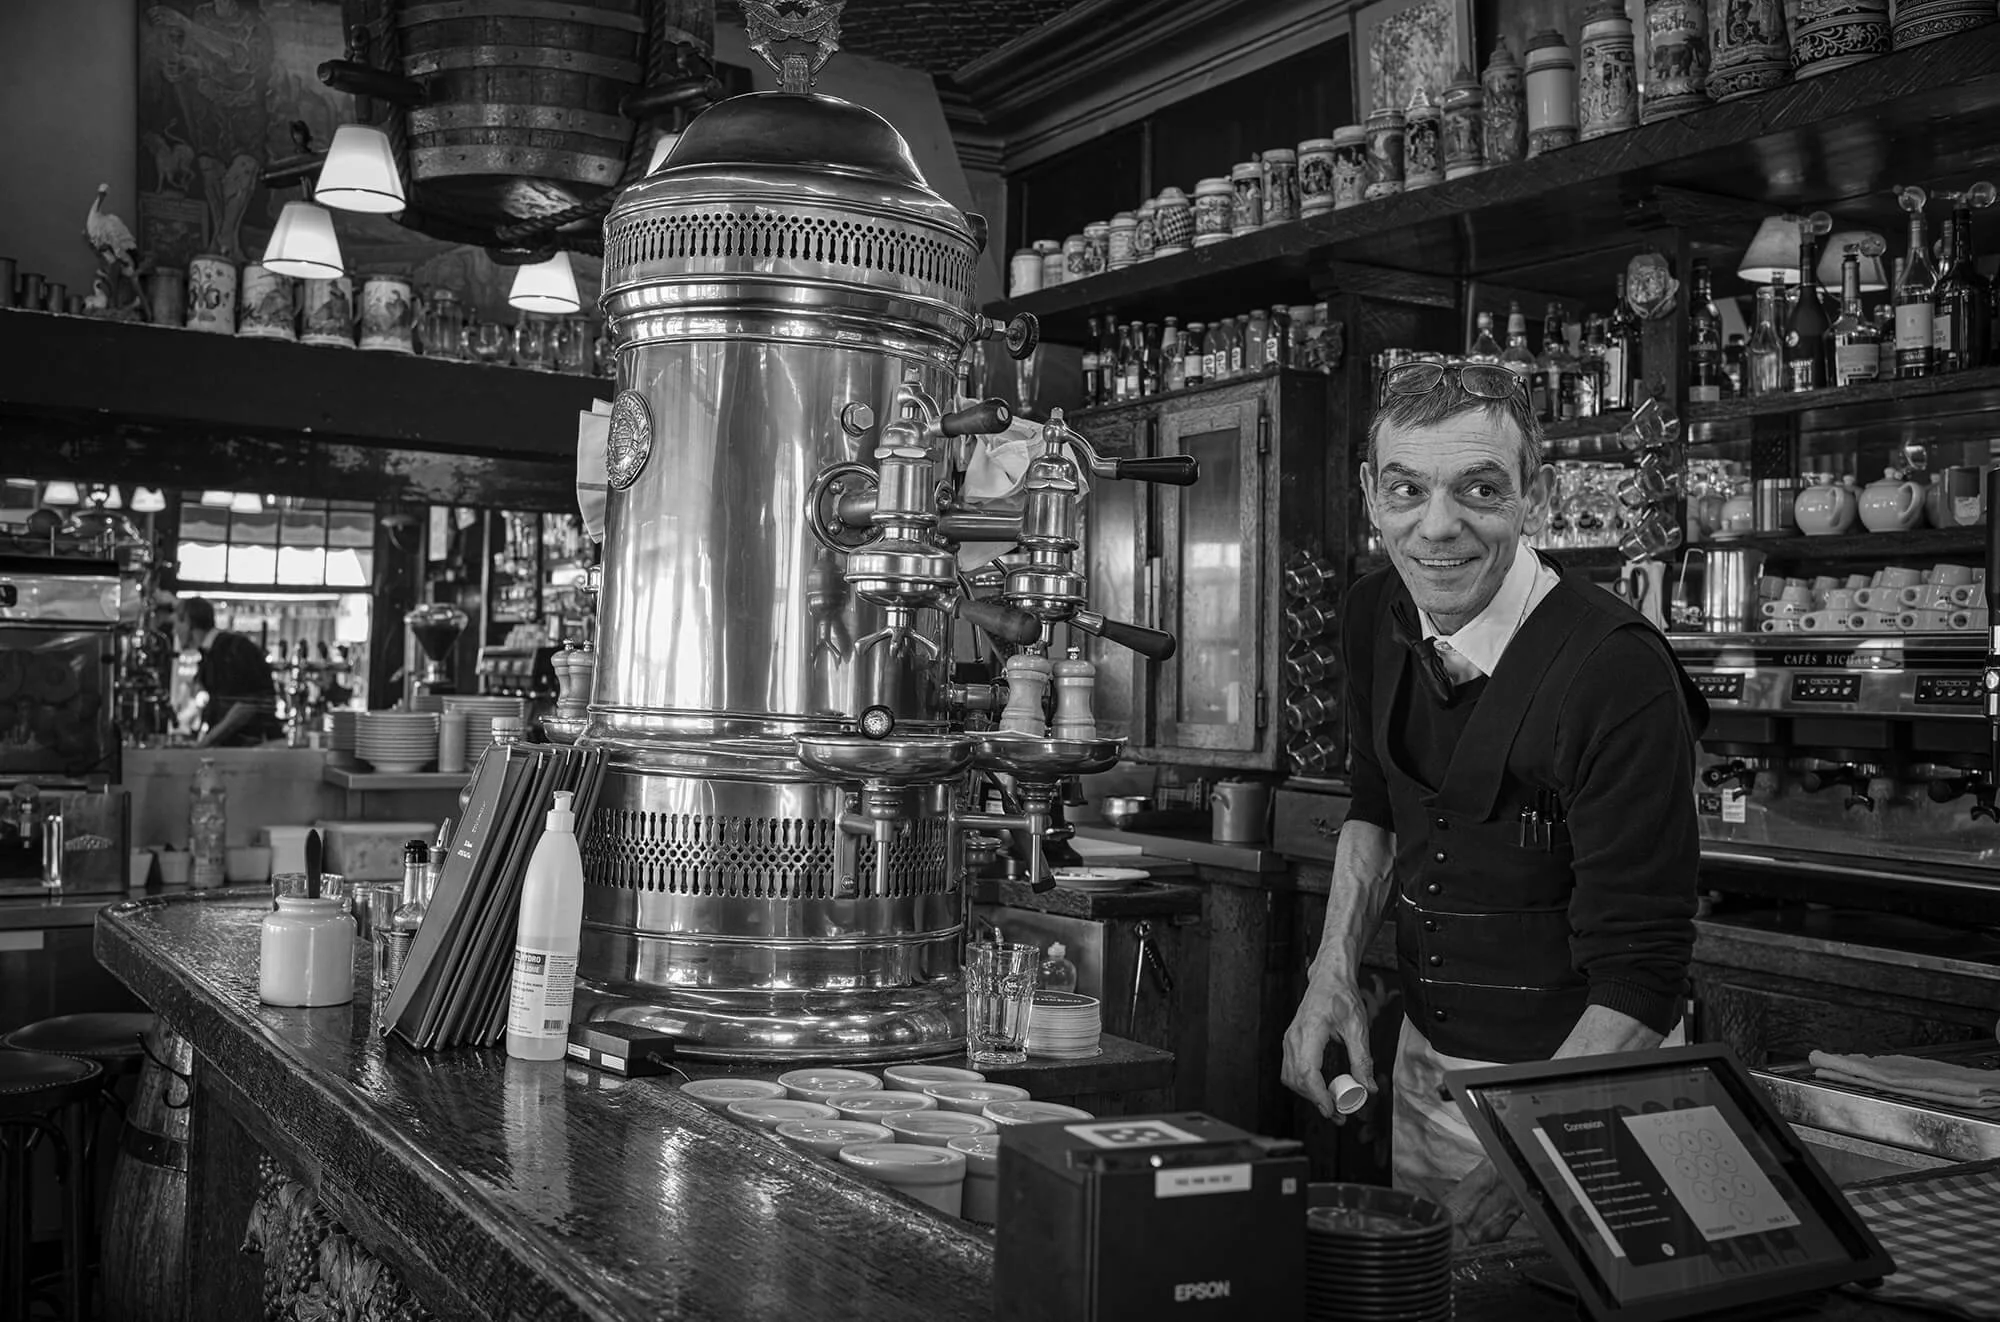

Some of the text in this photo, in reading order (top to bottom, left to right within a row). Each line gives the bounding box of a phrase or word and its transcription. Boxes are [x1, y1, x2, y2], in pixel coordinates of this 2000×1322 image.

[1783, 653, 1877, 666] CAFÉS RICHAR
[1174, 1281, 1230, 1301] EPSON
